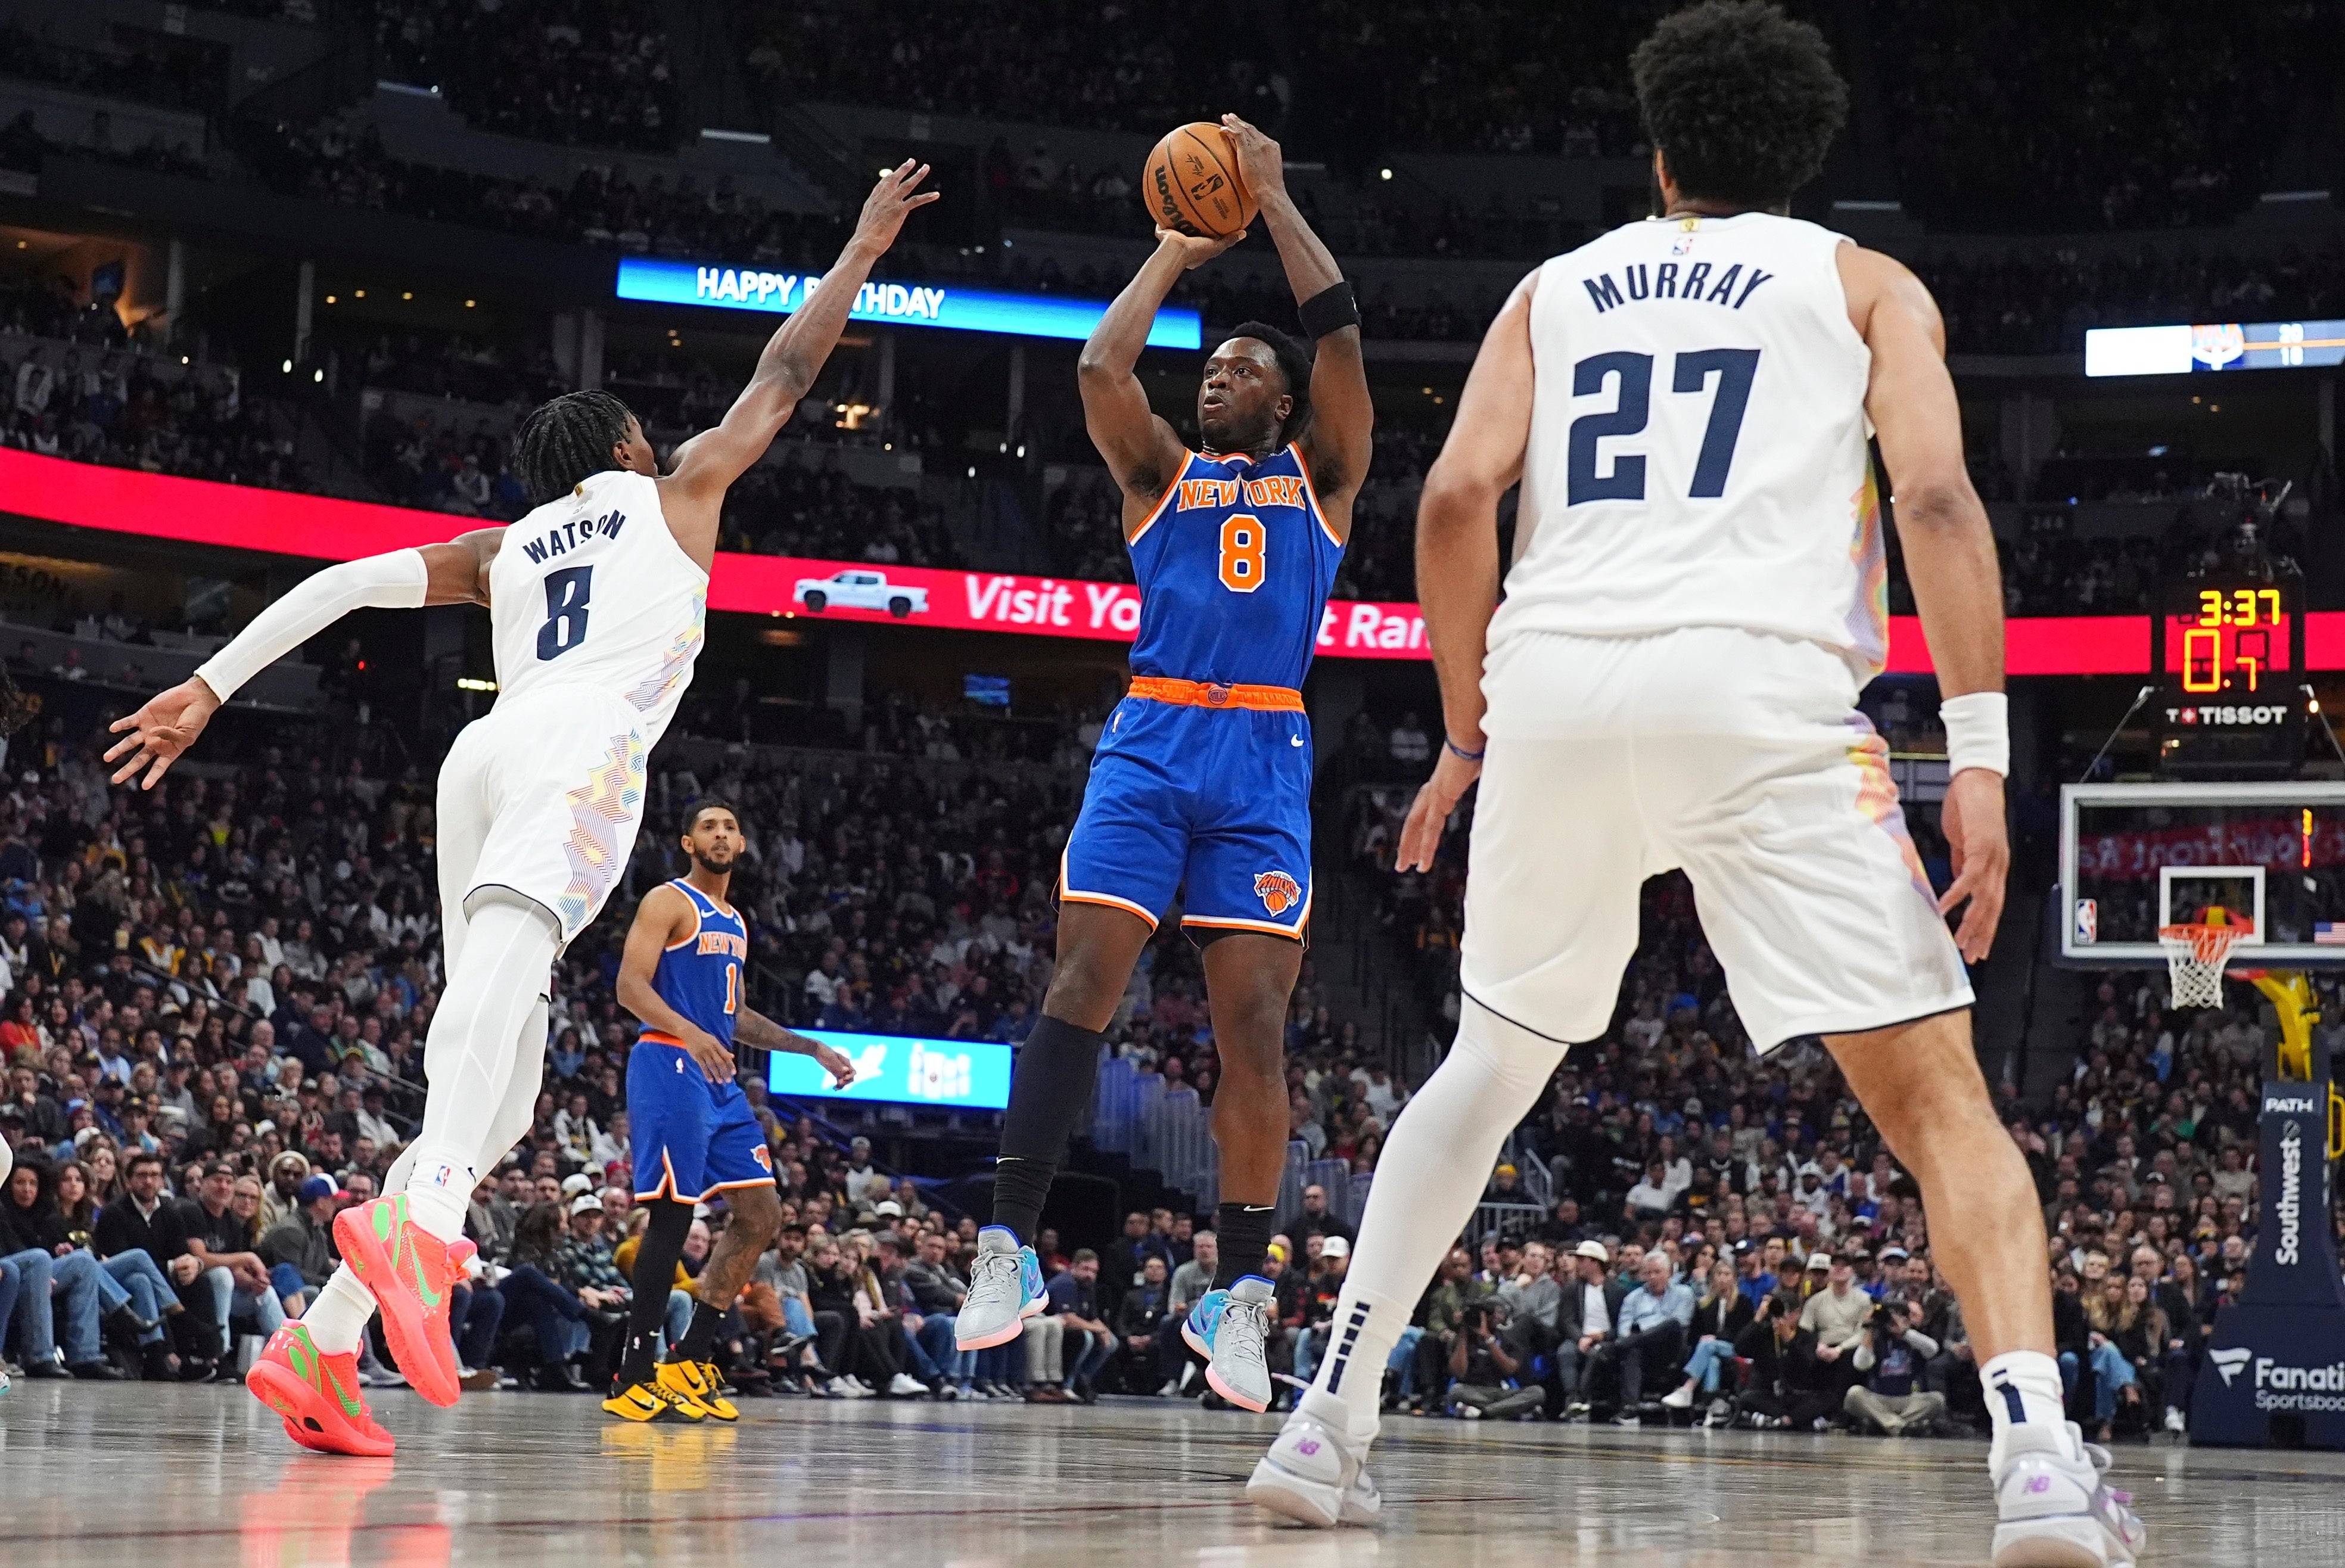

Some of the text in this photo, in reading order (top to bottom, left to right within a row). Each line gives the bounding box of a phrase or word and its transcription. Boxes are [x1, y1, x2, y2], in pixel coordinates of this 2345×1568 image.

[696, 266, 945, 319] HAPPY THDAY
[1582, 262, 1774, 313] MURRAY
[1568, 348, 1761, 507] 27
[1176, 471, 1242, 513] NEW
[522, 509, 627, 565] WATSON
[1218, 513, 1267, 593] 8
[536, 564, 595, 661] 8
[966, 574, 1074, 627] Visit
[2199, 589, 2280, 627] 3:37
[2184, 628, 2257, 693] 0.7
[2198, 705, 2288, 725] TISSOT
[1256, 873, 1297, 902] KNICKS
[696, 931, 731, 956] NEW
[723, 962, 737, 1015] 1
[2265, 1097, 2314, 1113] PATH
[2275, 1136, 2302, 1265] Southwest
[2255, 1357, 2345, 1392] Fanati
